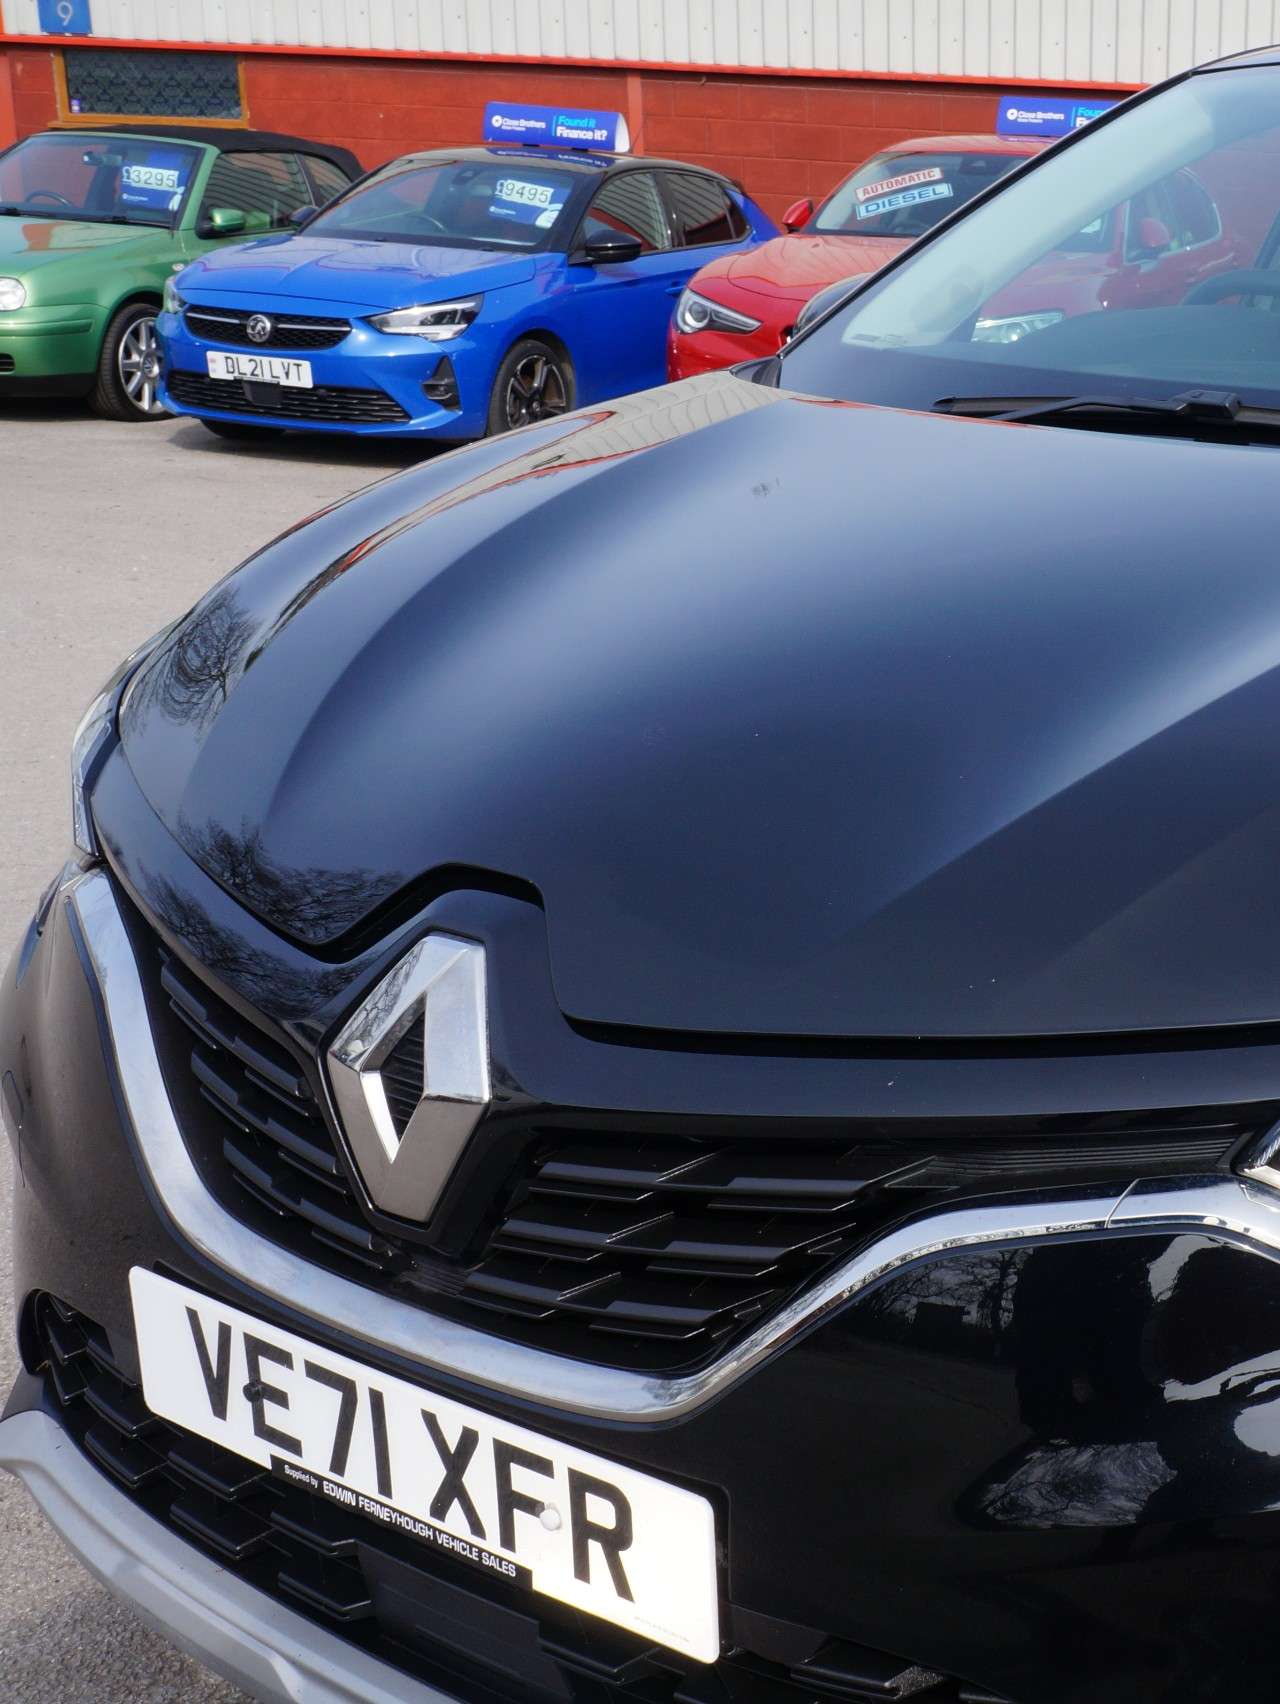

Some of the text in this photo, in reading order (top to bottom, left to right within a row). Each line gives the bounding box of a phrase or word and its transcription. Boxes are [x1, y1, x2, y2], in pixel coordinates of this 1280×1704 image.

[57, 1, 73, 26] 9
[557, 126, 608, 141] Finance it?
[558, 115, 597, 128] Found it
[496, 180, 549, 203] £9495
[862, 170, 936, 197] AUTOMATIC
[864, 187, 945, 214] DIESEL
[224, 356, 302, 382] DL21 LVT
[185, 1305, 635, 1603] VE71 XFR
[284, 1464, 517, 1577] Supplied by EDWIN FERNEYHOUGH VEHICLE SALES
